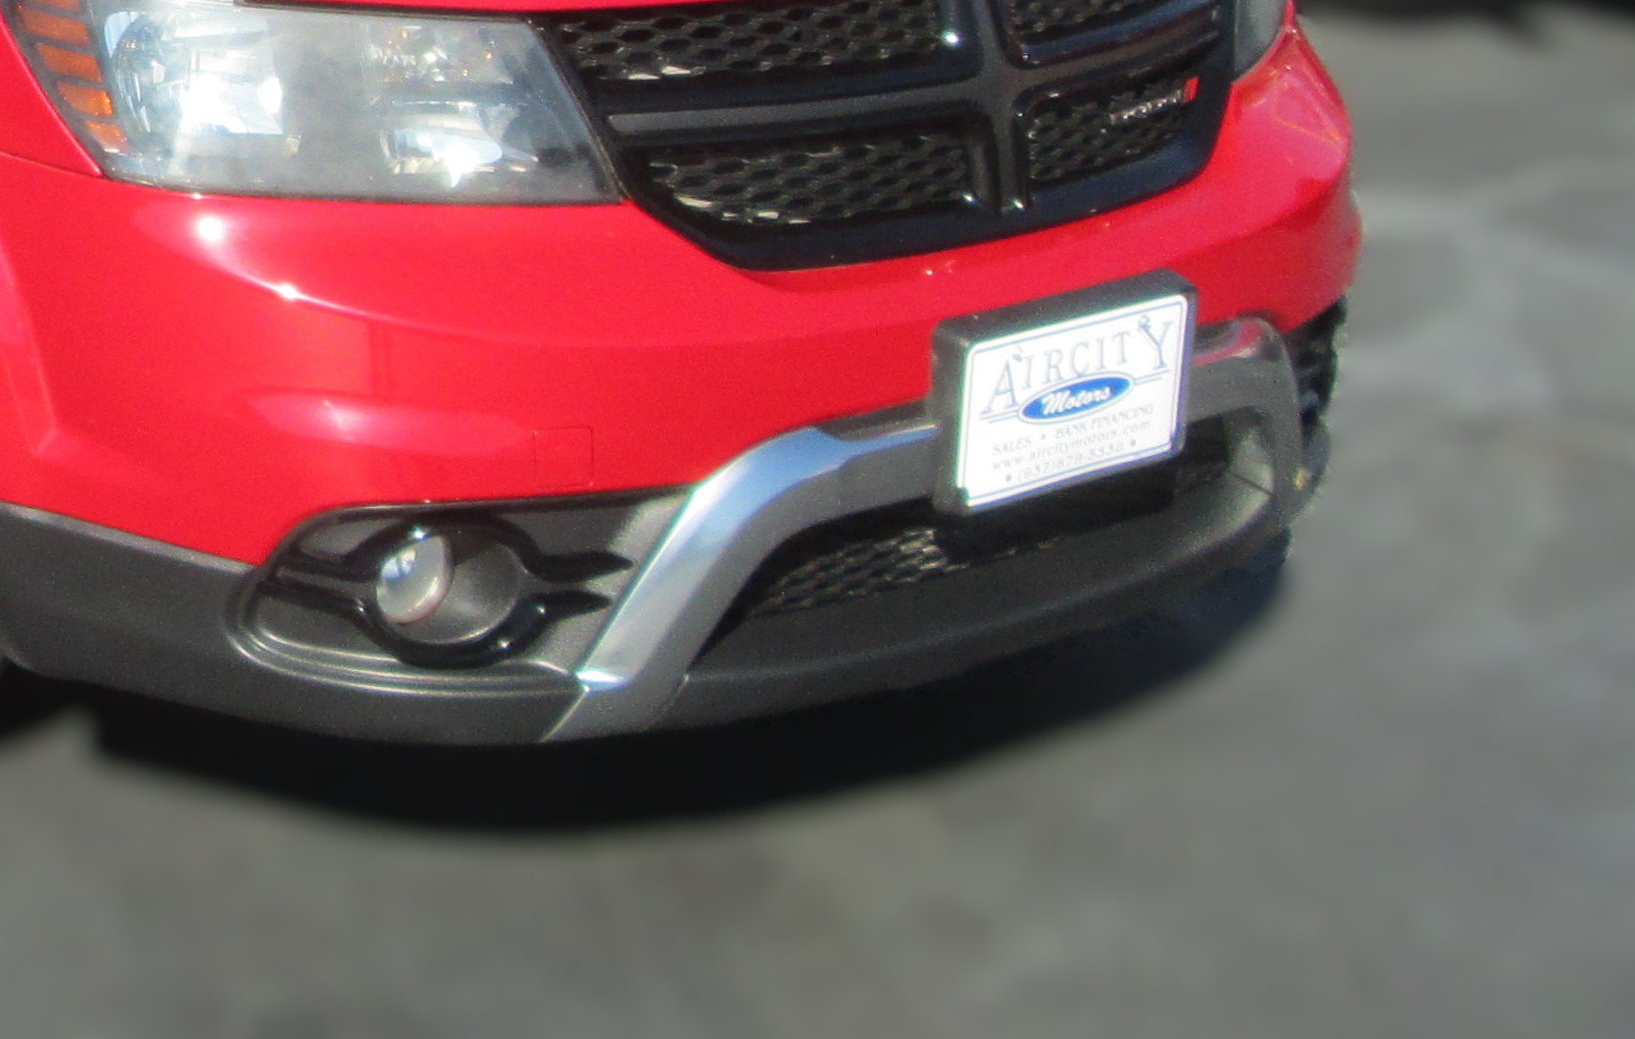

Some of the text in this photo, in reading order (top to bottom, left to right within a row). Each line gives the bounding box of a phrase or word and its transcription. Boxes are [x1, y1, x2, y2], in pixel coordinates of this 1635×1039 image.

[978, 317, 1175, 415] AIRCITY
[1041, 385, 1112, 417] Motors
[992, 436, 1033, 456] SALES
